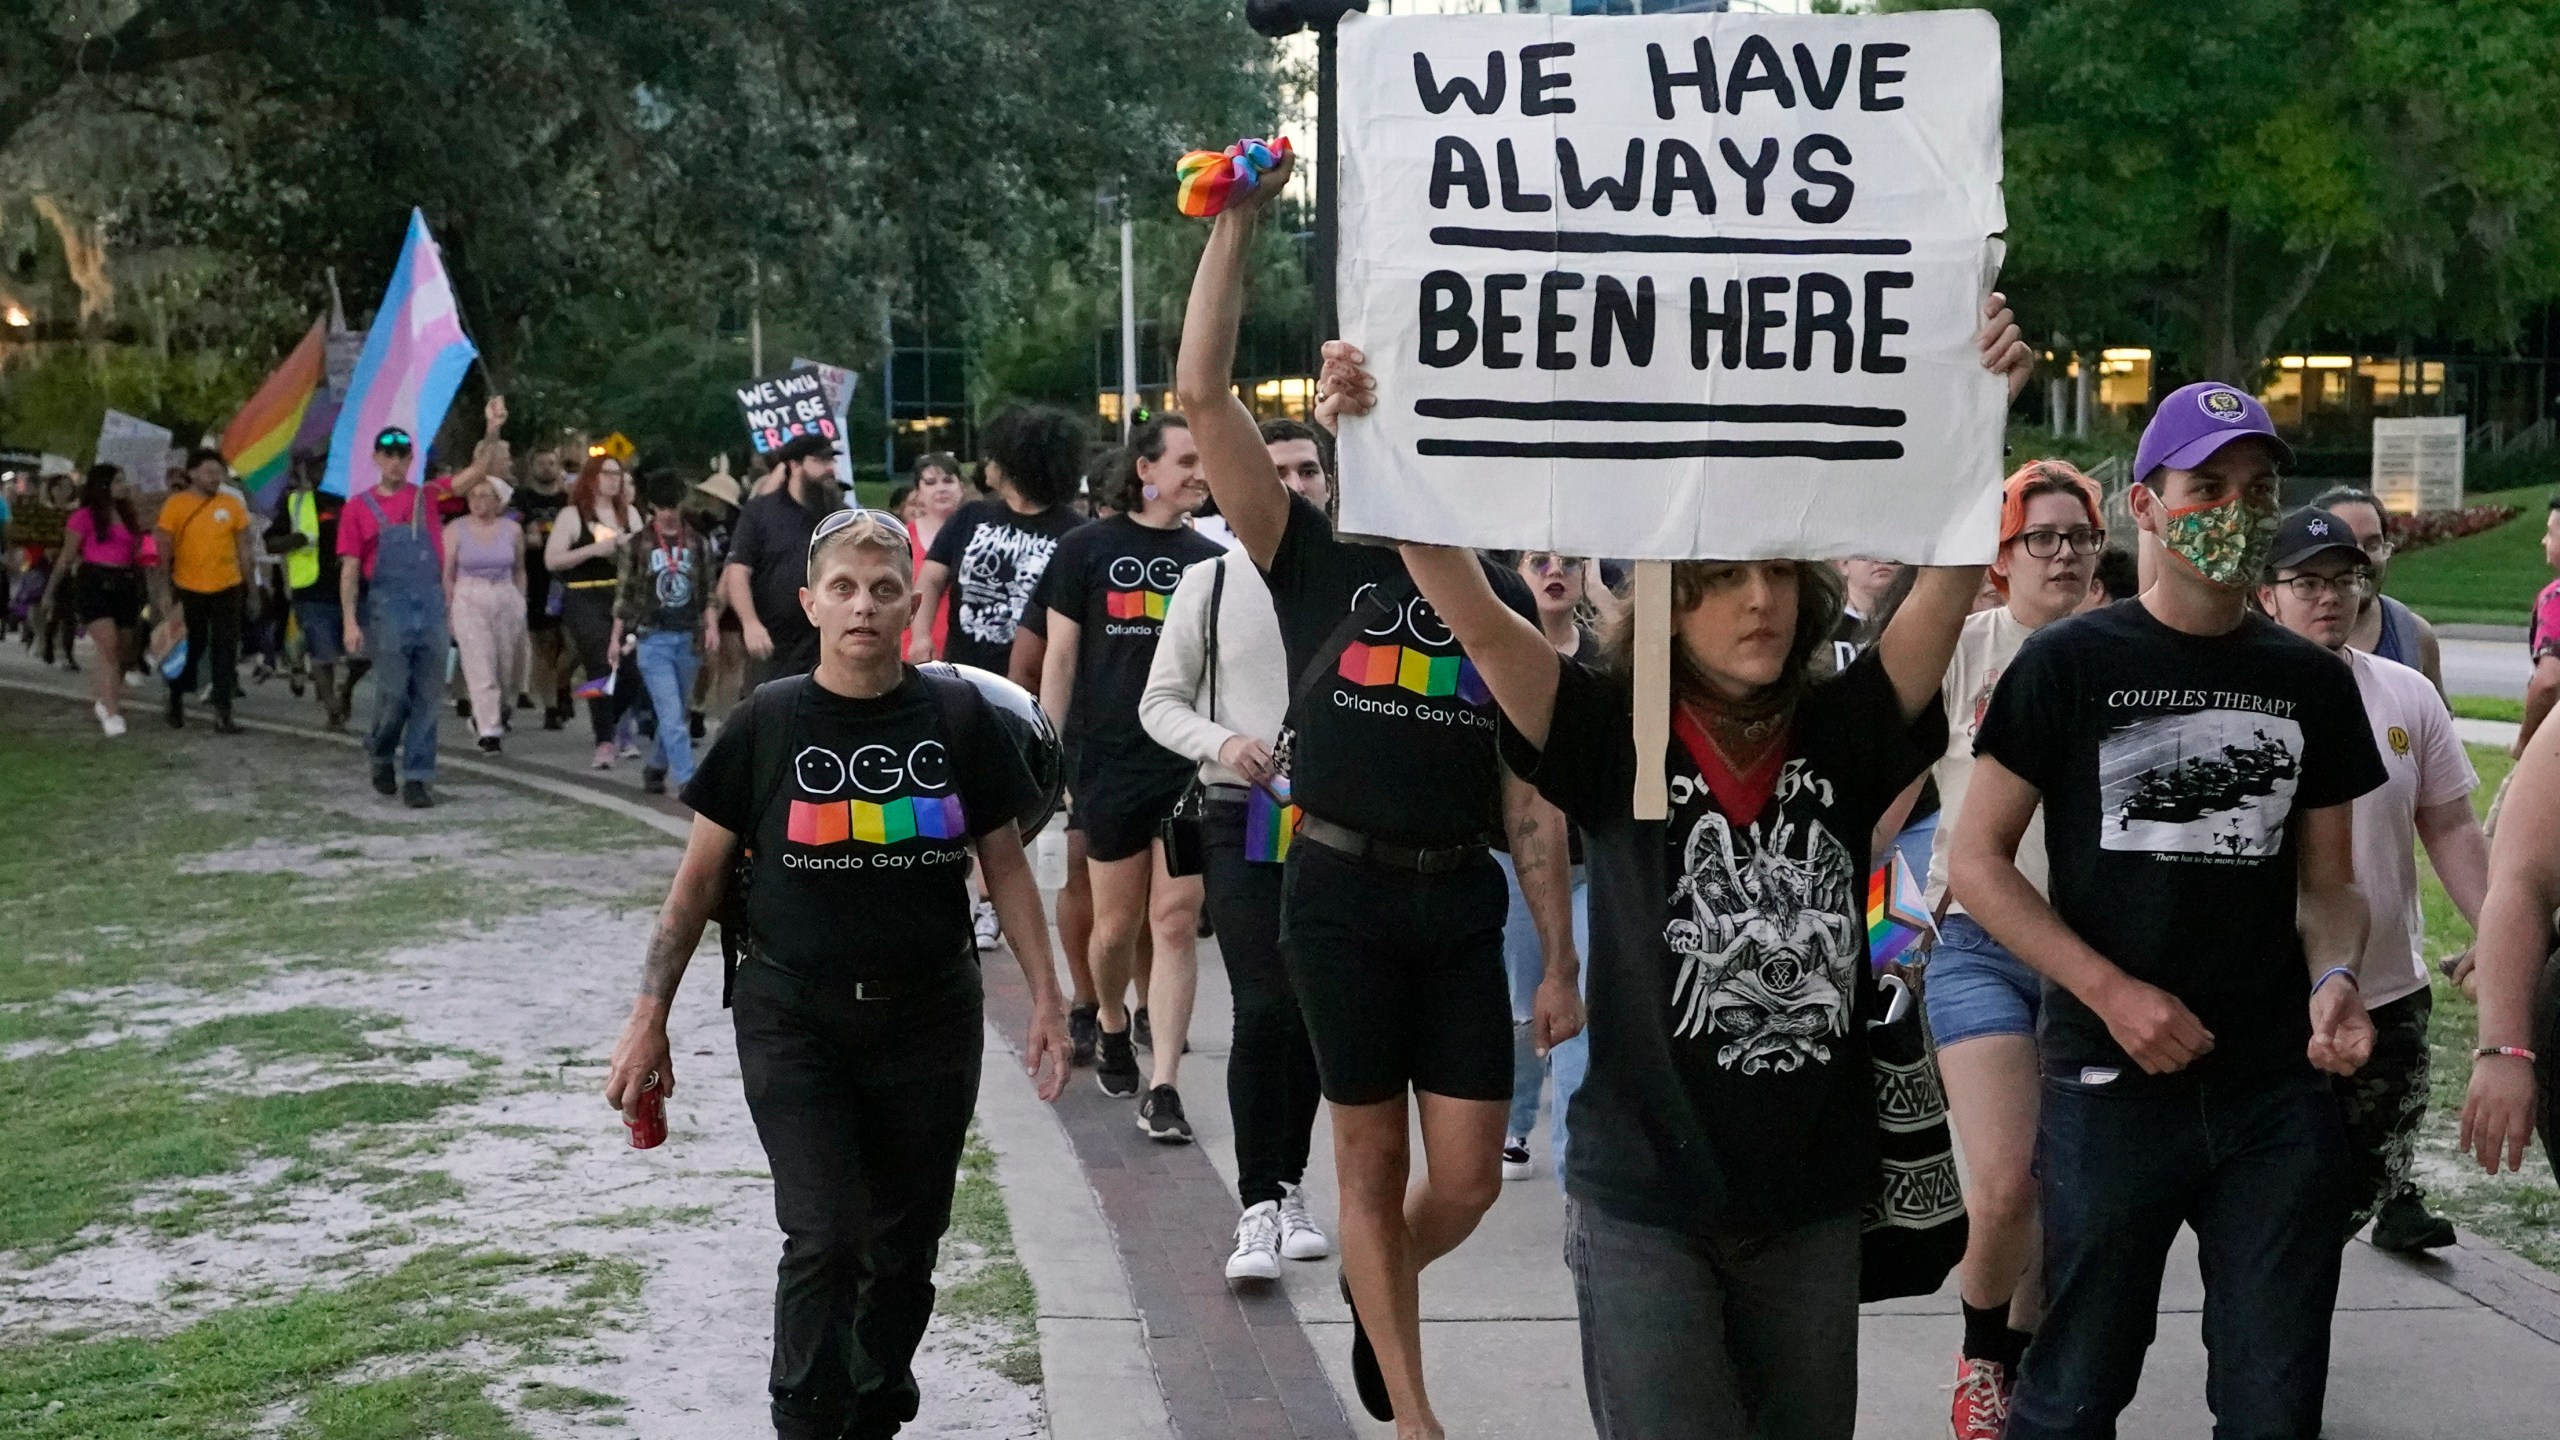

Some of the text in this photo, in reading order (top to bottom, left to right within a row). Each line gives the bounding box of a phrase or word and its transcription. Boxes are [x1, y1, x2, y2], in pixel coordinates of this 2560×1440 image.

[1413, 34, 1911, 120] WE HAVE
[1429, 133, 1855, 224] ALWAYS
[1418, 269, 1914, 374] BEEN HERE
[736, 382, 779, 407] WE
[775, 374, 819, 398] WILL
[747, 396, 826, 429] NOT BE
[1109, 556, 1195, 589] OG
[1105, 624, 1152, 635] Orlando
[1333, 690, 1409, 717] Orlando
[1415, 704, 1455, 726] Gay
[2108, 690, 2297, 718] COUPLES THERAPY
[782, 853, 864, 870] Orlando
[871, 853, 916, 870] Gay
[2202, 855, 2213, 864] be
[2214, 857, 2235, 865] more
[2235, 857, 2247, 866] for
